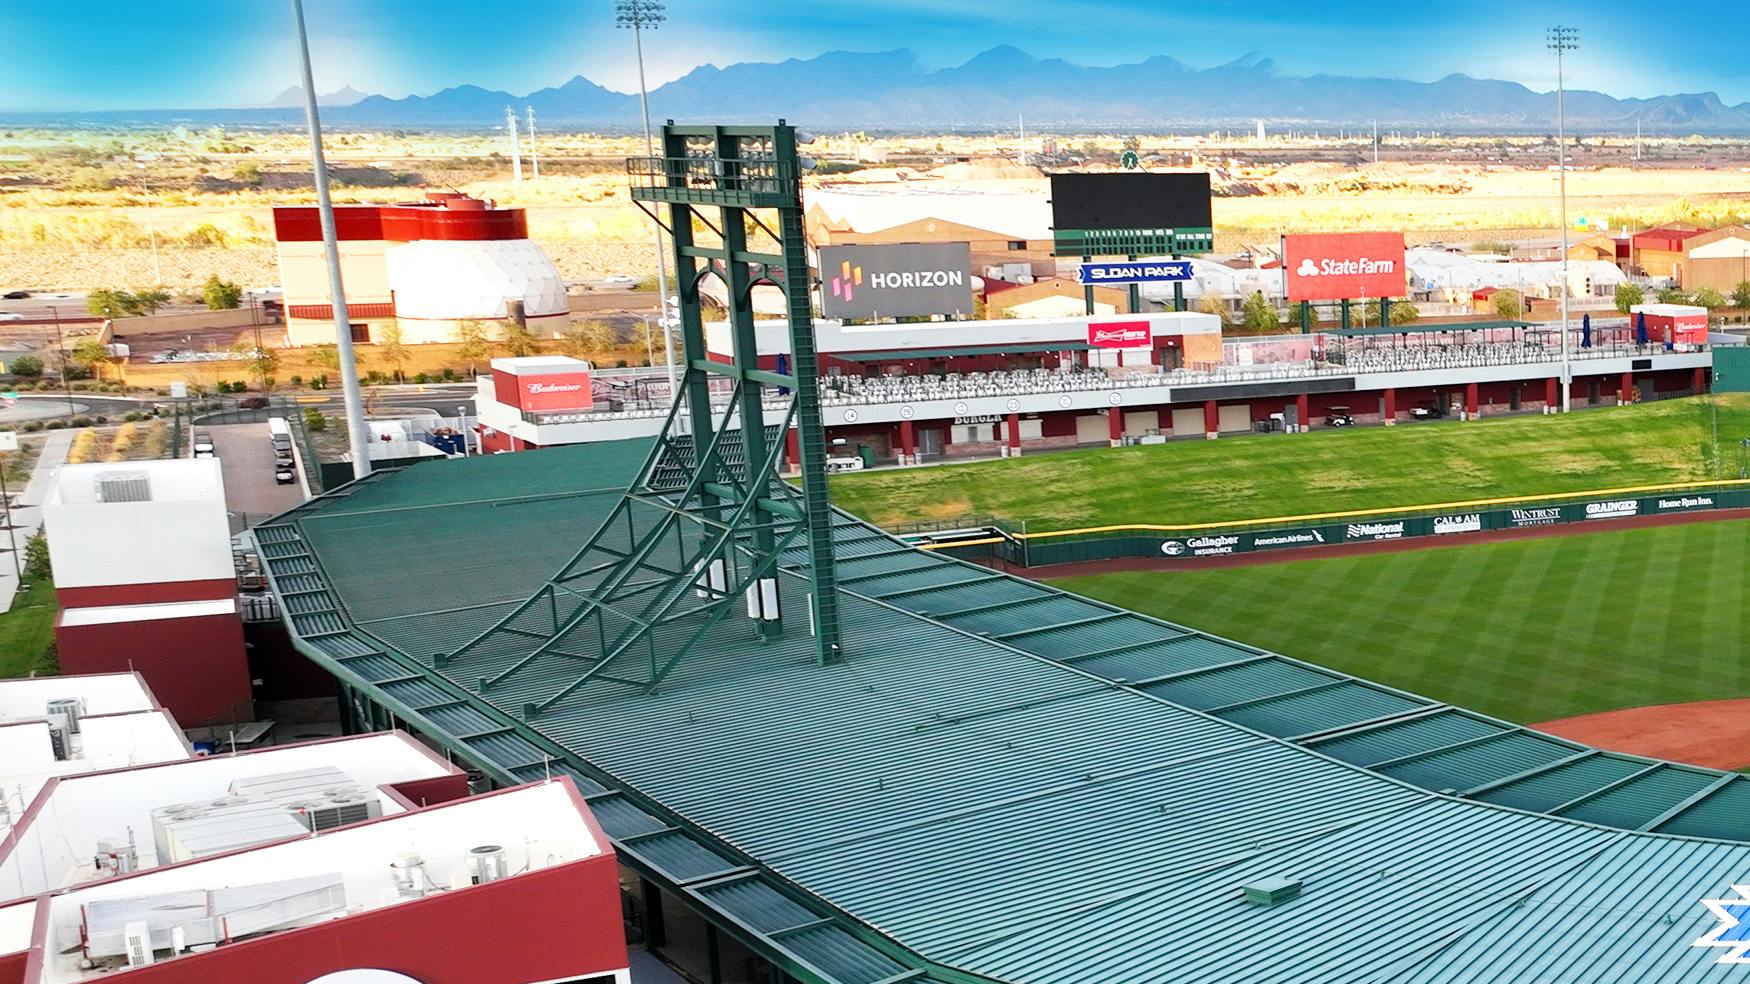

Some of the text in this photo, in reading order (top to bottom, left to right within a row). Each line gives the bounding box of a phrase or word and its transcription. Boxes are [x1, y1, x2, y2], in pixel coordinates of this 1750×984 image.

[1090, 266, 1184, 279] SLOAN PARK
[1320, 257, 1394, 275] State Farm
[871, 270, 963, 289] HORIZON
[1676, 321, 1706, 332] Budweiser
[527, 383, 584, 394] Budweiser
[1586, 500, 1638, 513] GRAINGER
[1658, 499, 1681, 509] Home
[1681, 498, 1698, 507] Run
[1511, 508, 1560, 519] WINTRUST
[1360, 521, 1405, 536] National
[1186, 535, 1239, 548] Gallagher
[1194, 546, 1233, 555] INSURANCE
